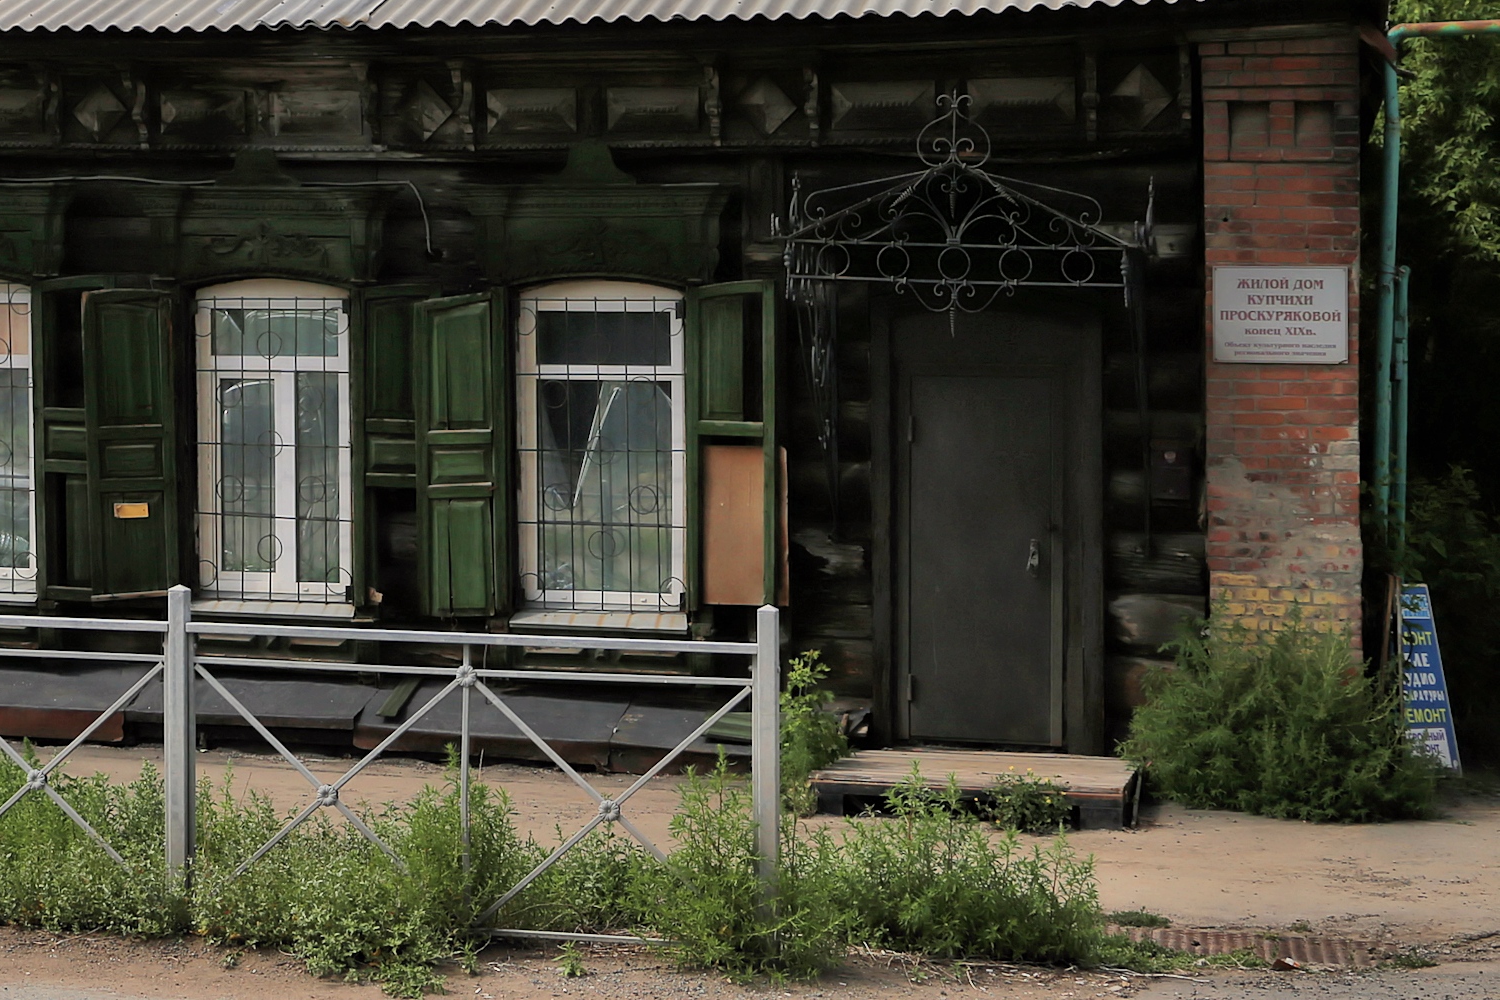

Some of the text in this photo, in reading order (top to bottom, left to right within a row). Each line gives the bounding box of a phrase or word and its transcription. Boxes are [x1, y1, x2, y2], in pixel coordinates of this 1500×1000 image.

[1237, 277, 1324, 291] ЖИЛОЙ ДОМ
[1247, 294, 1314, 306] КУПЧИХИ
[1220, 309, 1342, 322] ПРОСКУРЯКОВОЙ
[1244, 327, 1282, 337] конец
[1402, 672, 1437, 688] УДИО
[1405, 708, 1447, 723] ЕМОНТ
